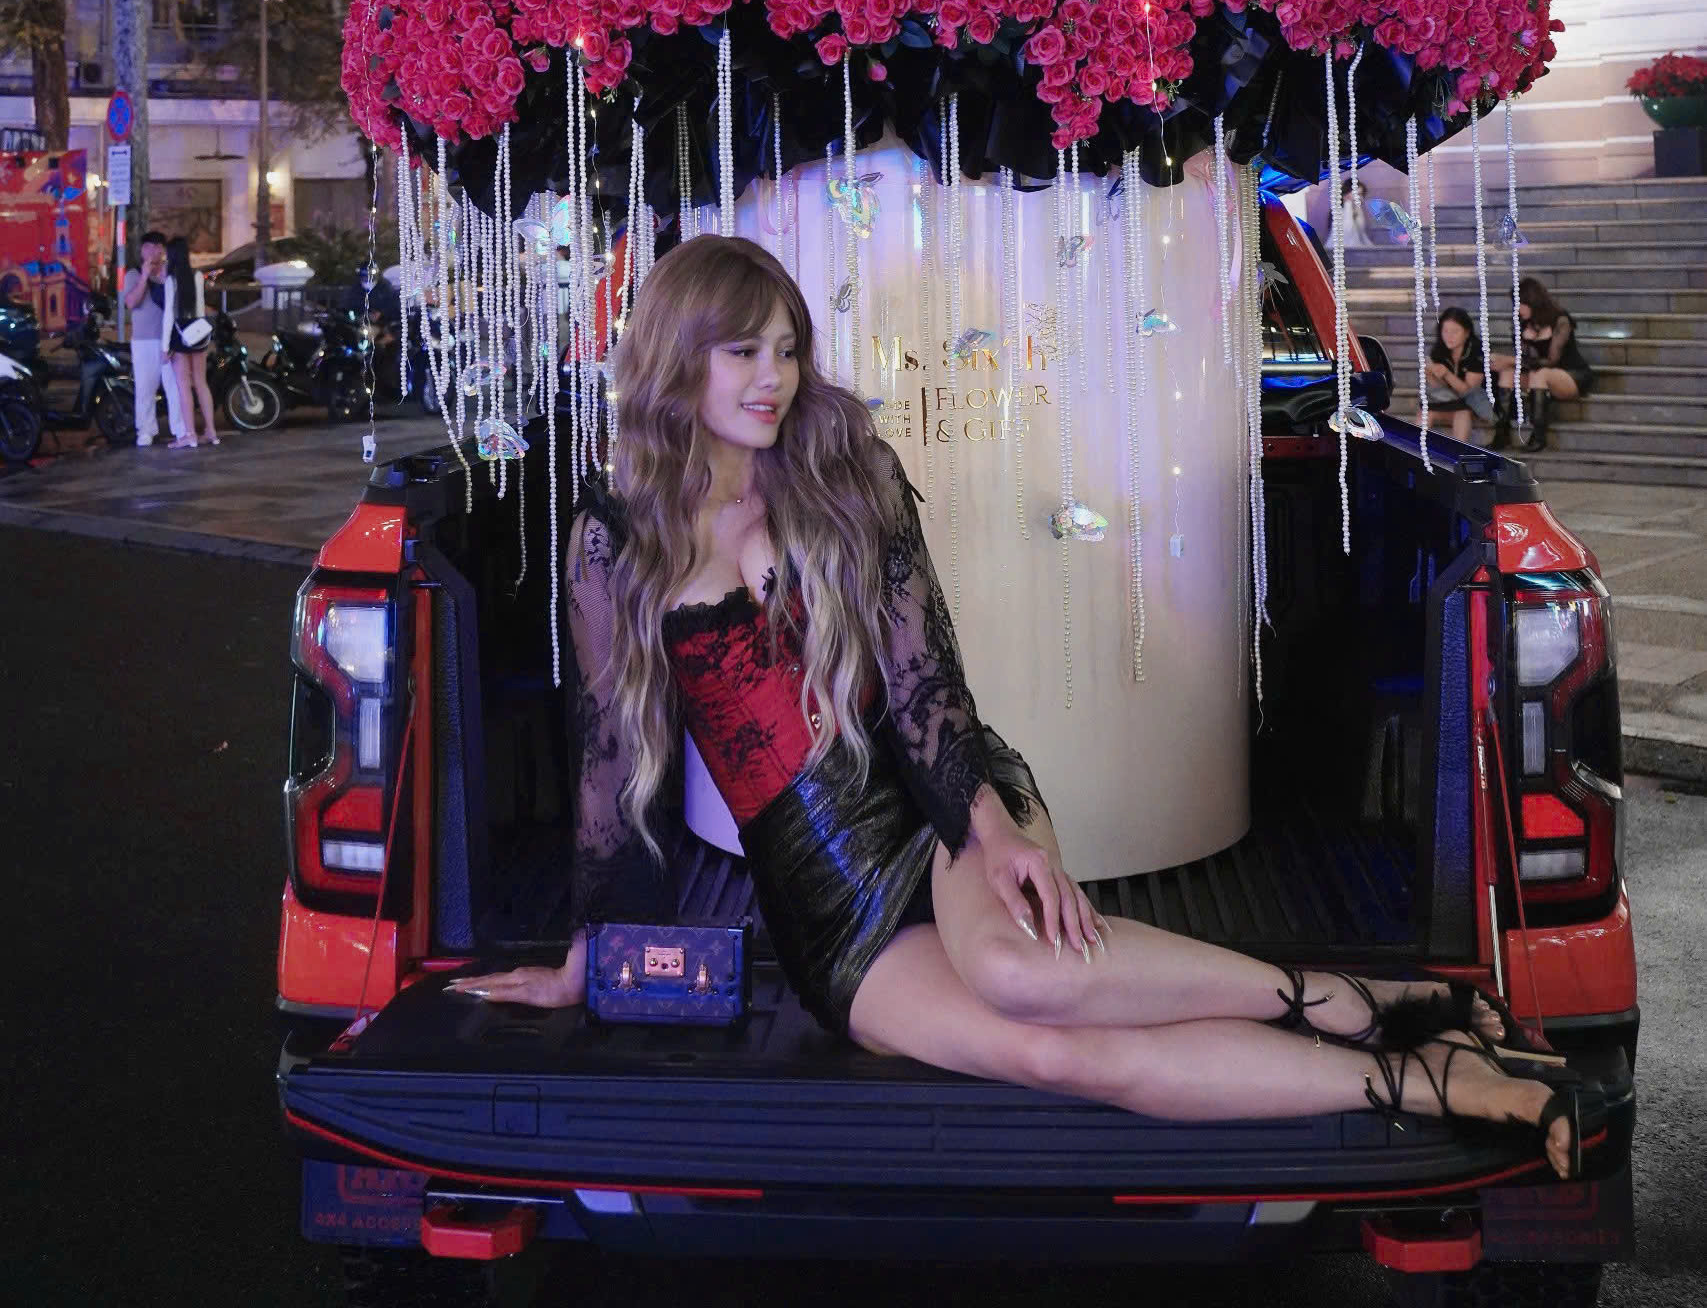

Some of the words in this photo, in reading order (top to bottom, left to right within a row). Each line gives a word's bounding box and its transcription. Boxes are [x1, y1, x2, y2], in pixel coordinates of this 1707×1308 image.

[871, 334, 928, 371] Ms.
[942, 334, 1047, 371] Six'h
[935, 385, 1052, 411] FLOWER
[878, 413, 912, 425] WITH
[936, 418, 959, 443] &
